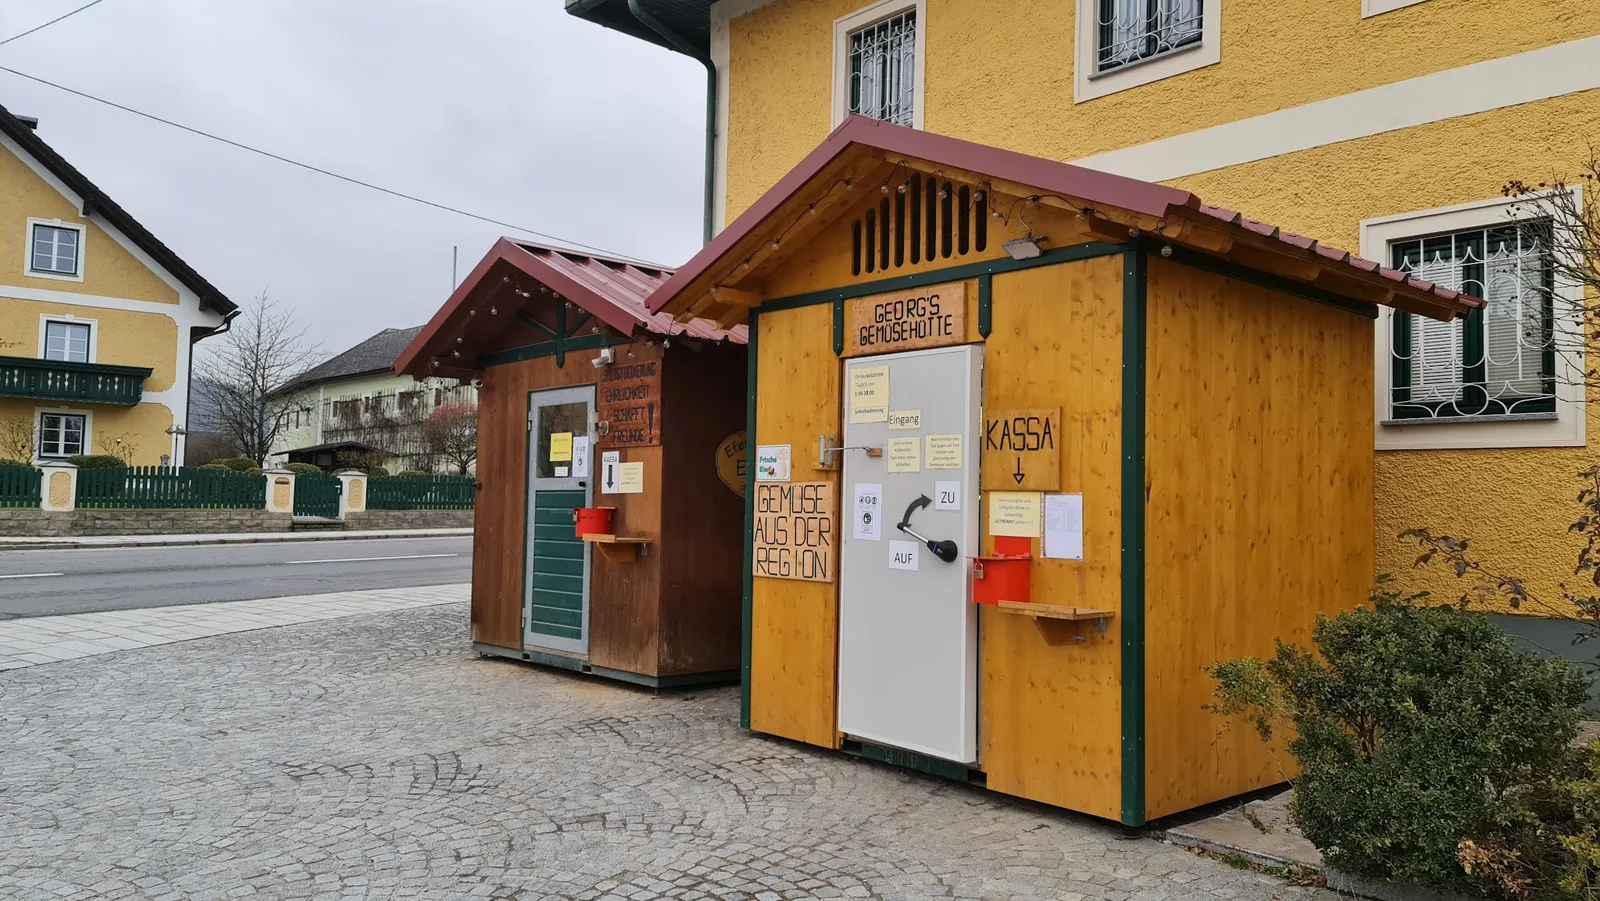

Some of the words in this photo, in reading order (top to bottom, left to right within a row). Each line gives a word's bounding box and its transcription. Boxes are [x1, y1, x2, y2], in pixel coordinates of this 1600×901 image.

[875, 294, 939, 323] GEORG'S
[860, 315, 952, 346] GEMÜSEHÜTTE
[603, 362, 656, 382] SELBSTBEDIENUNG
[605, 385, 650, 402] EHRLICHKEIT
[613, 406, 644, 423] SCHAFFT
[889, 414, 919, 426] Eingang
[613, 428, 644, 443] FREUNDE
[986, 417, 1053, 452] KASSA
[604, 455, 618, 463] KASSA
[759, 456, 777, 464] Frische
[758, 485, 827, 517] GEMÜSE
[941, 492, 955, 504] ZU
[754, 516, 788, 545] AUS
[795, 517, 831, 547] DER
[757, 547, 826, 579] REGION
[894, 553, 912, 564] AUF
